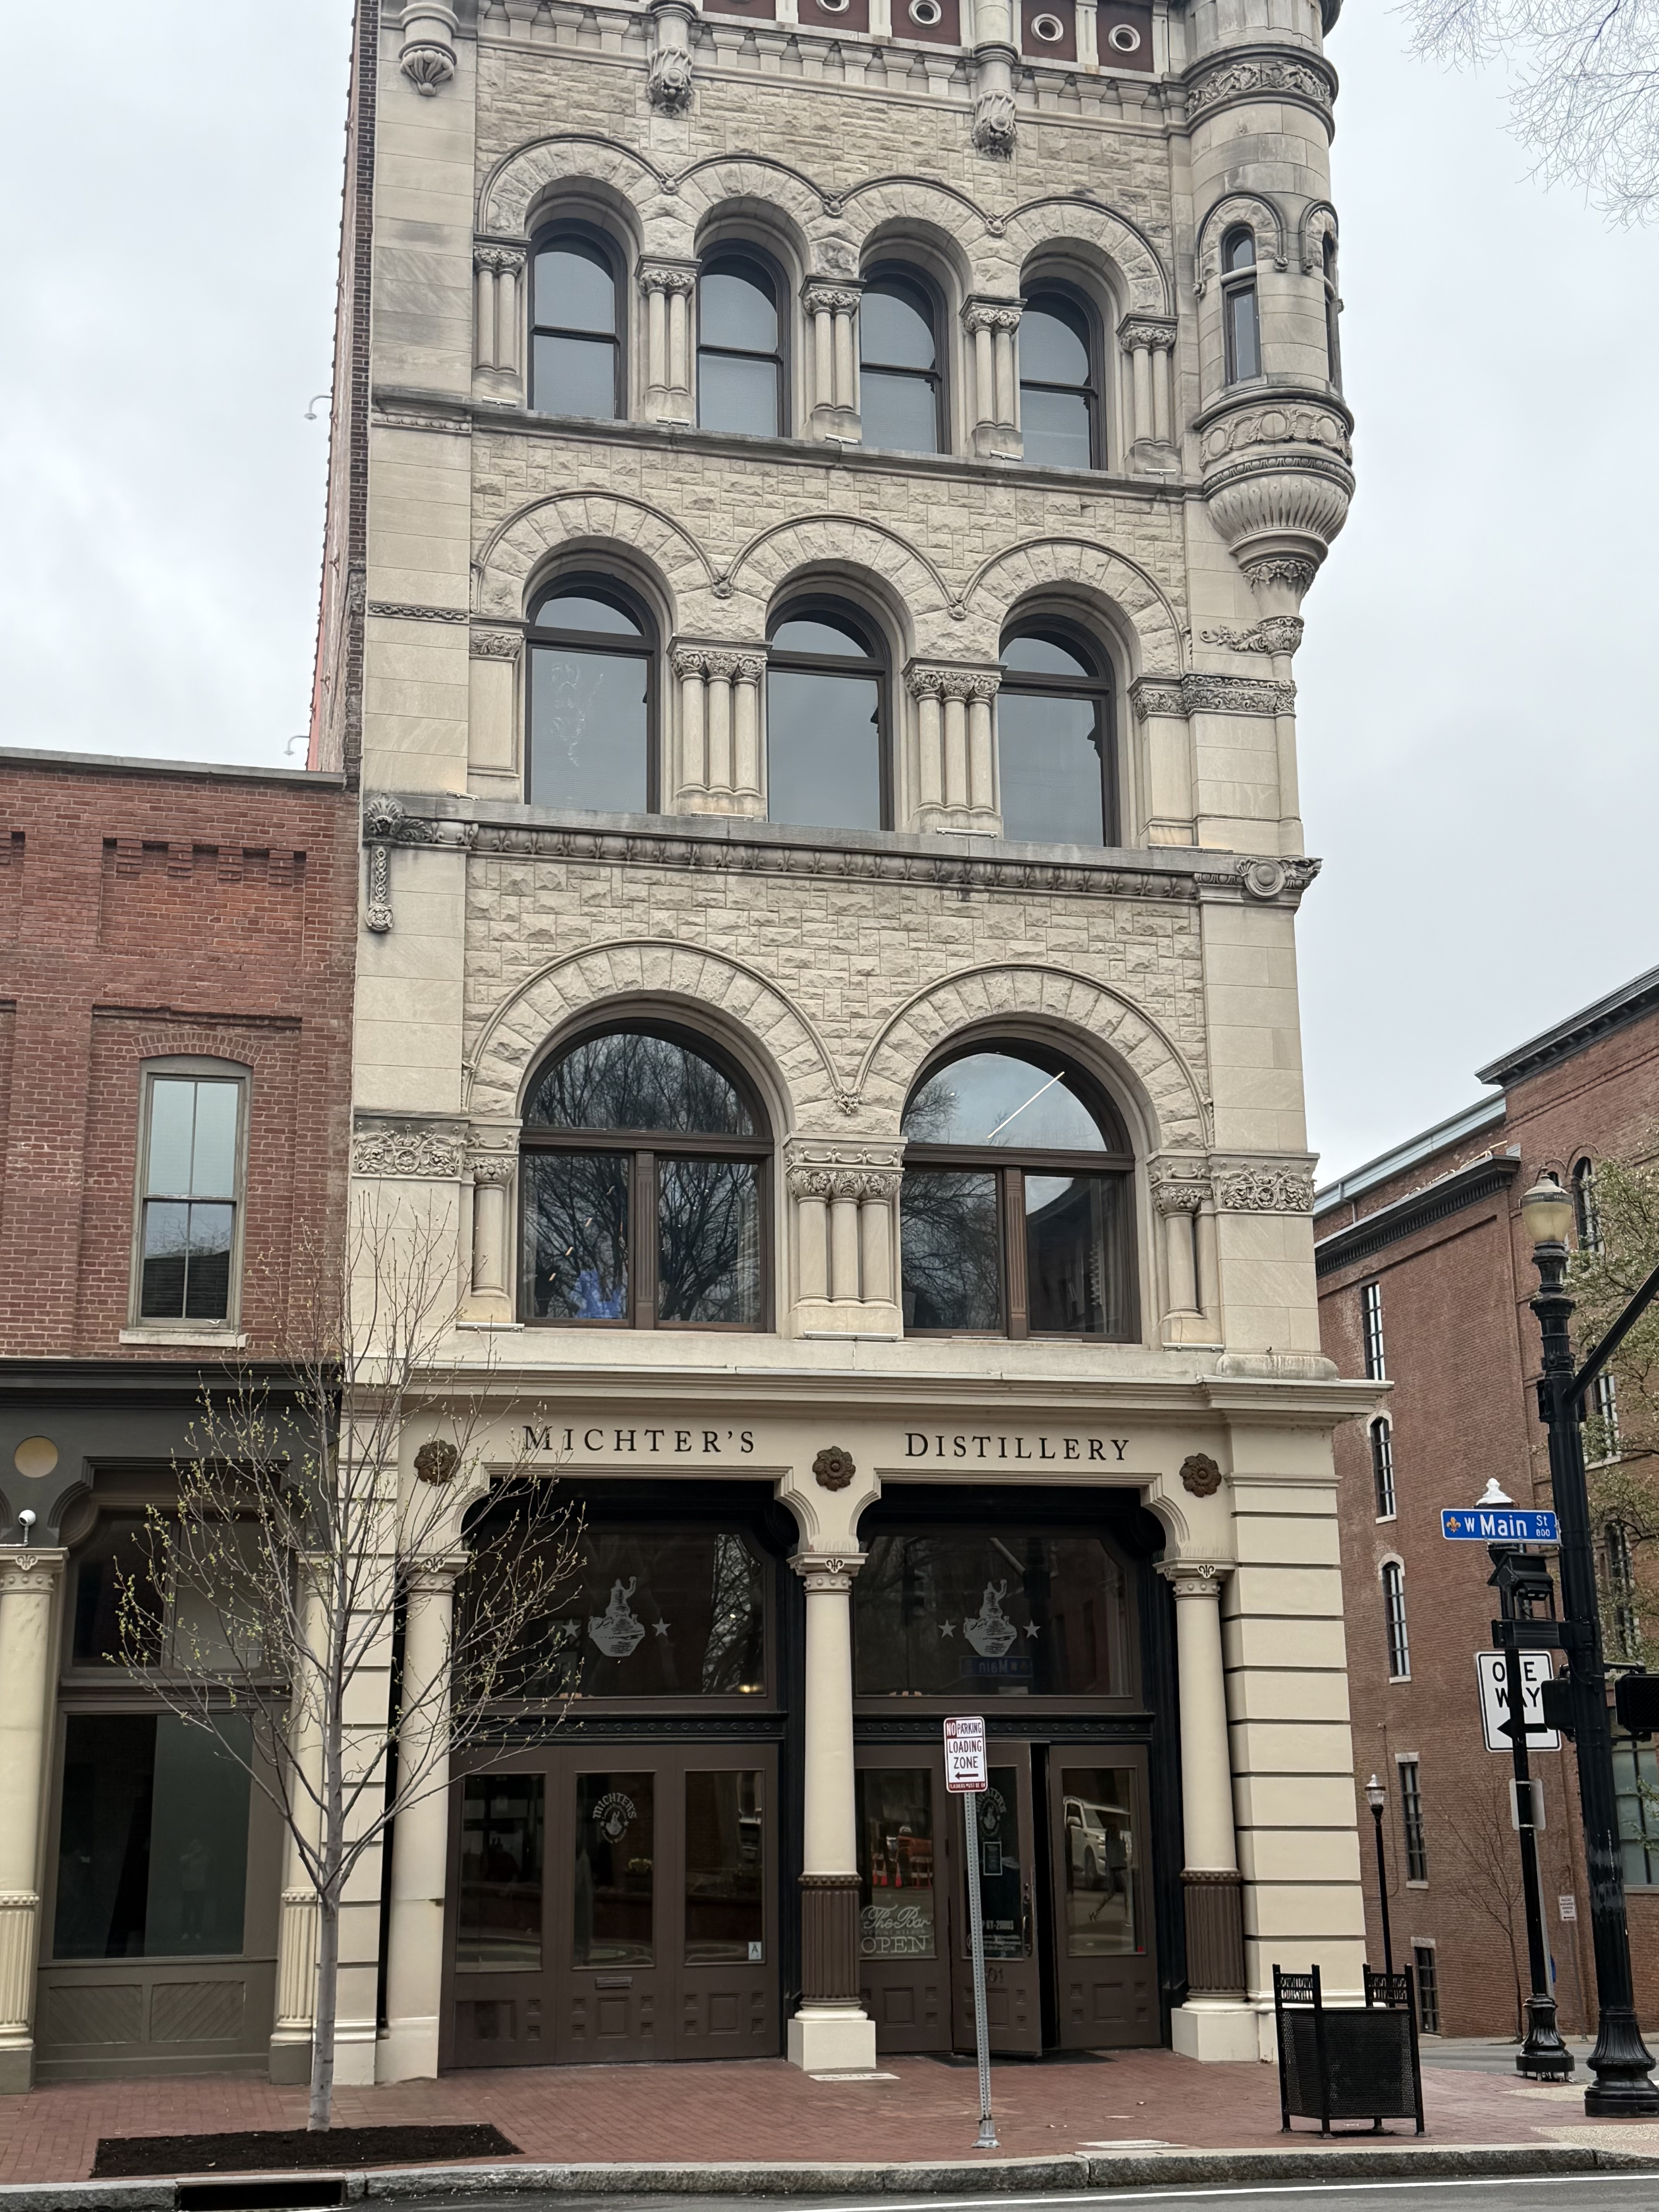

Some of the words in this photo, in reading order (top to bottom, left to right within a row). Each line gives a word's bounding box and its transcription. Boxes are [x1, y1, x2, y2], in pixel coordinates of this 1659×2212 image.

[522, 1425, 754, 1453] MICHTER'S
[905, 1433, 1129, 1460] DISTILLERY
[1464, 1517, 1475, 1532] W
[1480, 1515, 1527, 1536] Main
[1536, 1515, 1548, 1527] St
[1536, 1529, 1550, 1537] 800
[1492, 1661, 1537, 1682] OE
[1495, 1687, 1540, 1708] WY
[946, 1722, 956, 1736] NO
[957, 1722, 982, 1735] PARKING
[949, 1740, 982, 1753] LOADING
[953, 1756, 979, 1769] ZONE
[592, 1792, 638, 1819] MICHTER'S
[861, 1904, 898, 1929] The
[893, 1906, 931, 1929] Bar
[752, 1944, 759, 1954] A
[861, 1935, 930, 1953] OPEN
[985, 1967, 1004, 1984] 01
